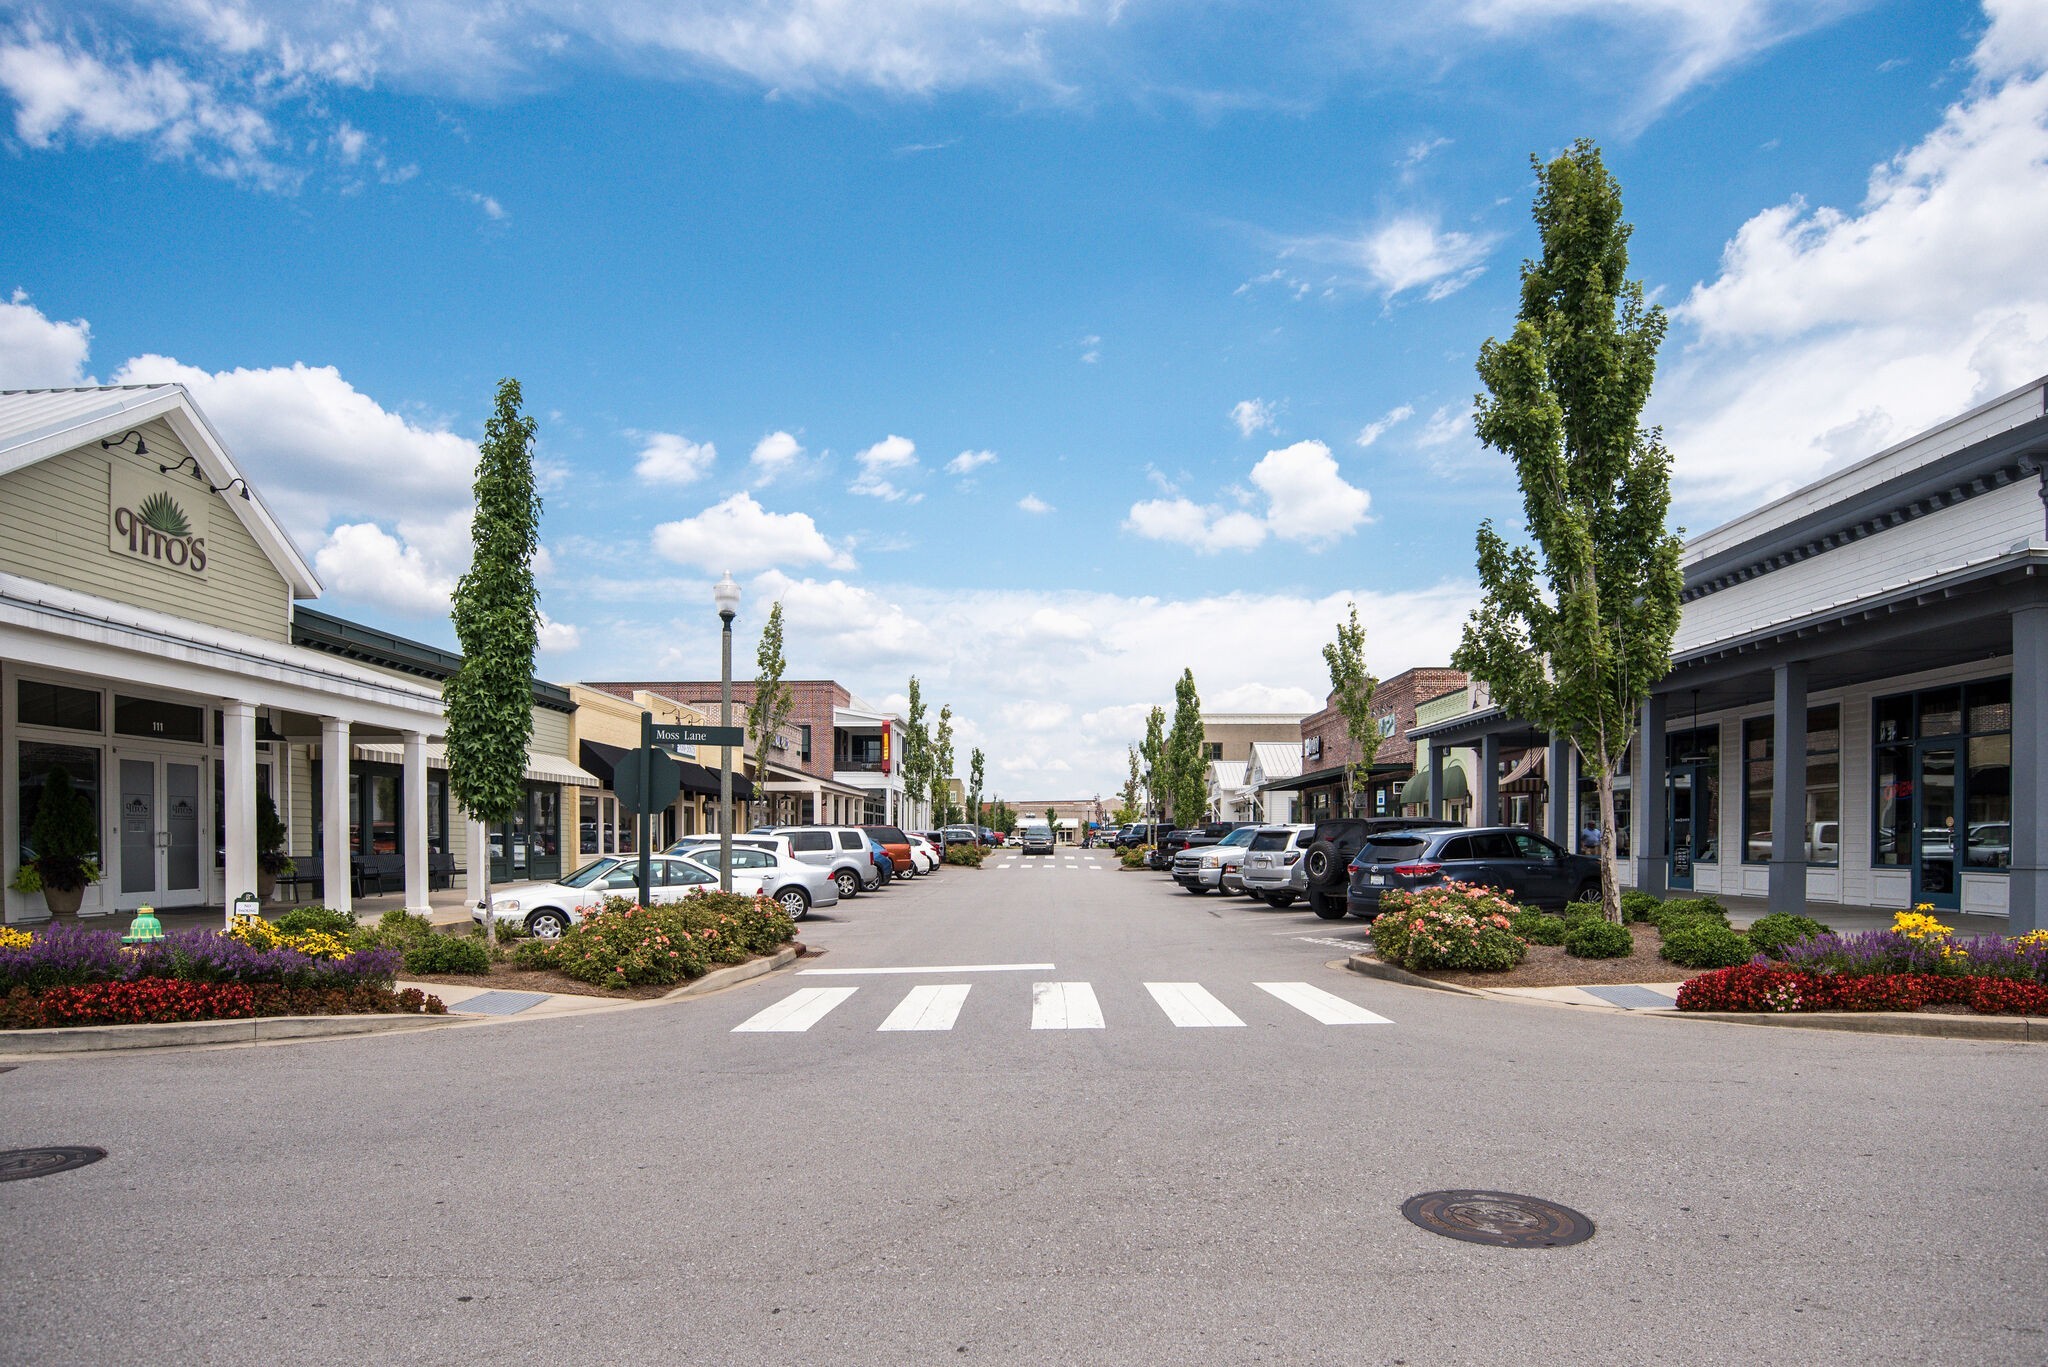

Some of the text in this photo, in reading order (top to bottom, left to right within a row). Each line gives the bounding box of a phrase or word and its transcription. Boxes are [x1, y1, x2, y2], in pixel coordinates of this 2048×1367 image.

[152, 721, 164, 732] 111
[656, 729, 707, 741] Moss Lane
